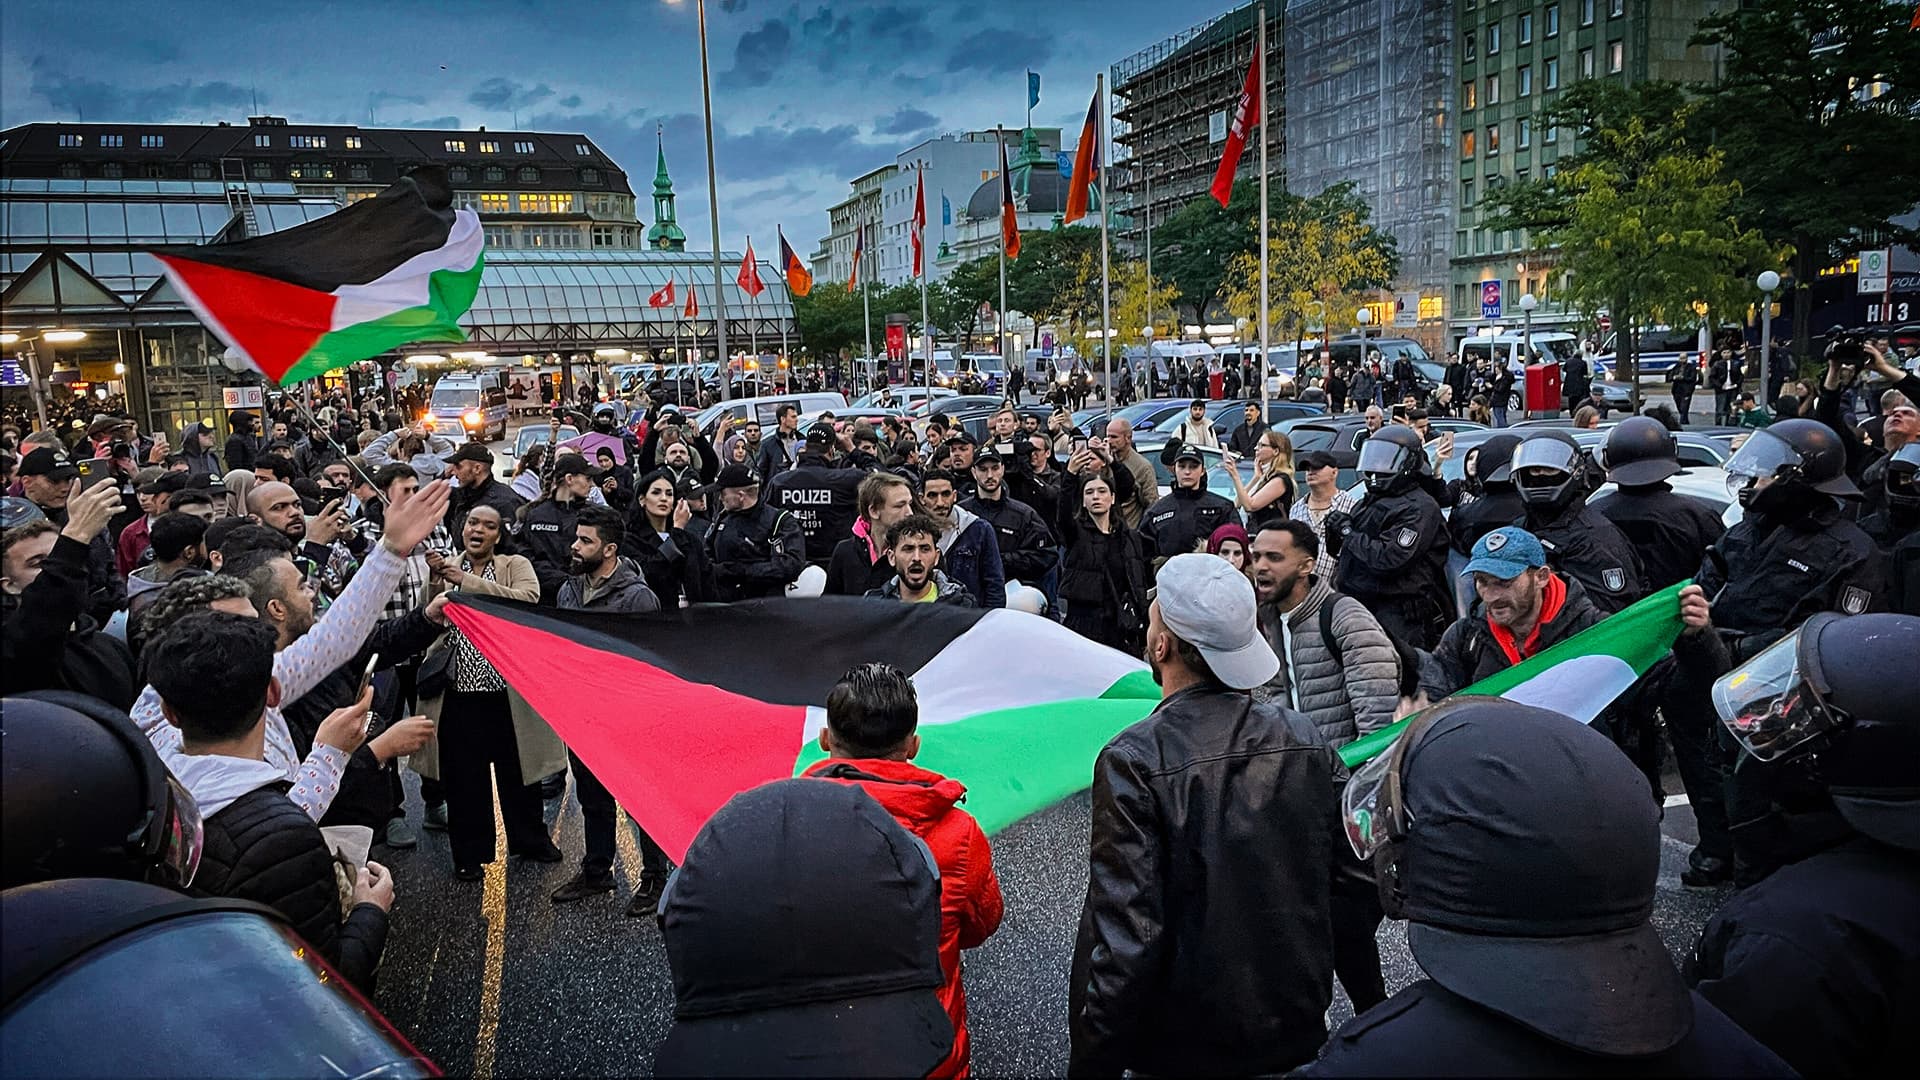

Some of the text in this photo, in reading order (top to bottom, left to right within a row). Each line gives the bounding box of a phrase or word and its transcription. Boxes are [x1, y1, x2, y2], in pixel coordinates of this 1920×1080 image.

[1483, 306, 1500, 316] TAXI
[782, 489, 831, 504] POLIZEI
[1152, 511, 1174, 524] POLIZEI
